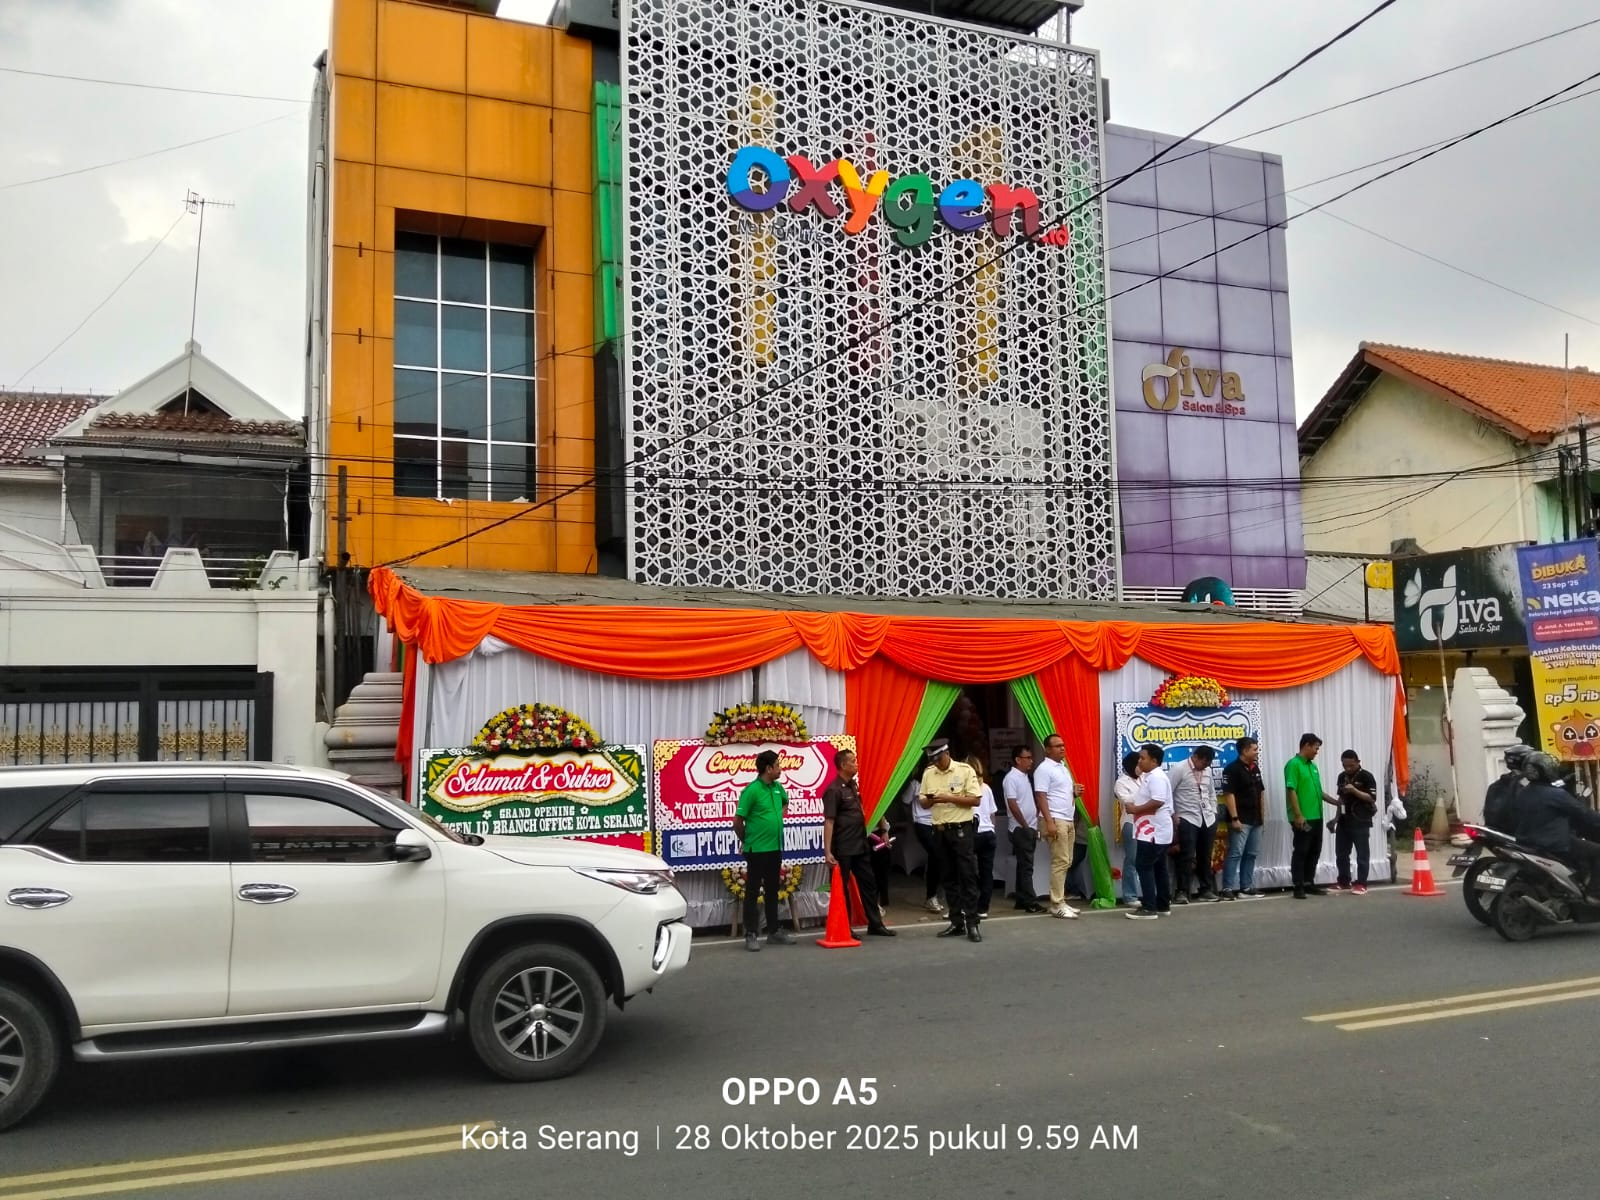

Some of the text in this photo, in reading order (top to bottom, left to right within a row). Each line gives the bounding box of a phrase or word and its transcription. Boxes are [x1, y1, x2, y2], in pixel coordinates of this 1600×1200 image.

[1182, 400, 1213, 413] Salon
[1224, 404, 1246, 416] Spa
[1532, 556, 1586, 581] DIBUKA
[1542, 582, 1551, 590] 23
[1552, 582, 1567, 590] Sep
[1459, 622, 1500, 634] Salon & Spa
[1532, 647, 1559, 656] Aneka
[1580, 689, 1600, 702] rib
[1133, 723, 1245, 744] Congratulations
[448, 763, 612, 794] Selamat & Sukses
[713, 790, 740, 802] GRA
[500, 806, 575, 819] GRAND OPENING
[788, 797, 824, 815] SERAN
[493, 819, 537, 834] BRANCH
[539, 816, 574, 832] OFFICE
[576, 815, 601, 830] KOTA
[603, 814, 643, 829] SERANG
[783, 825, 825, 851] KOMPUT
